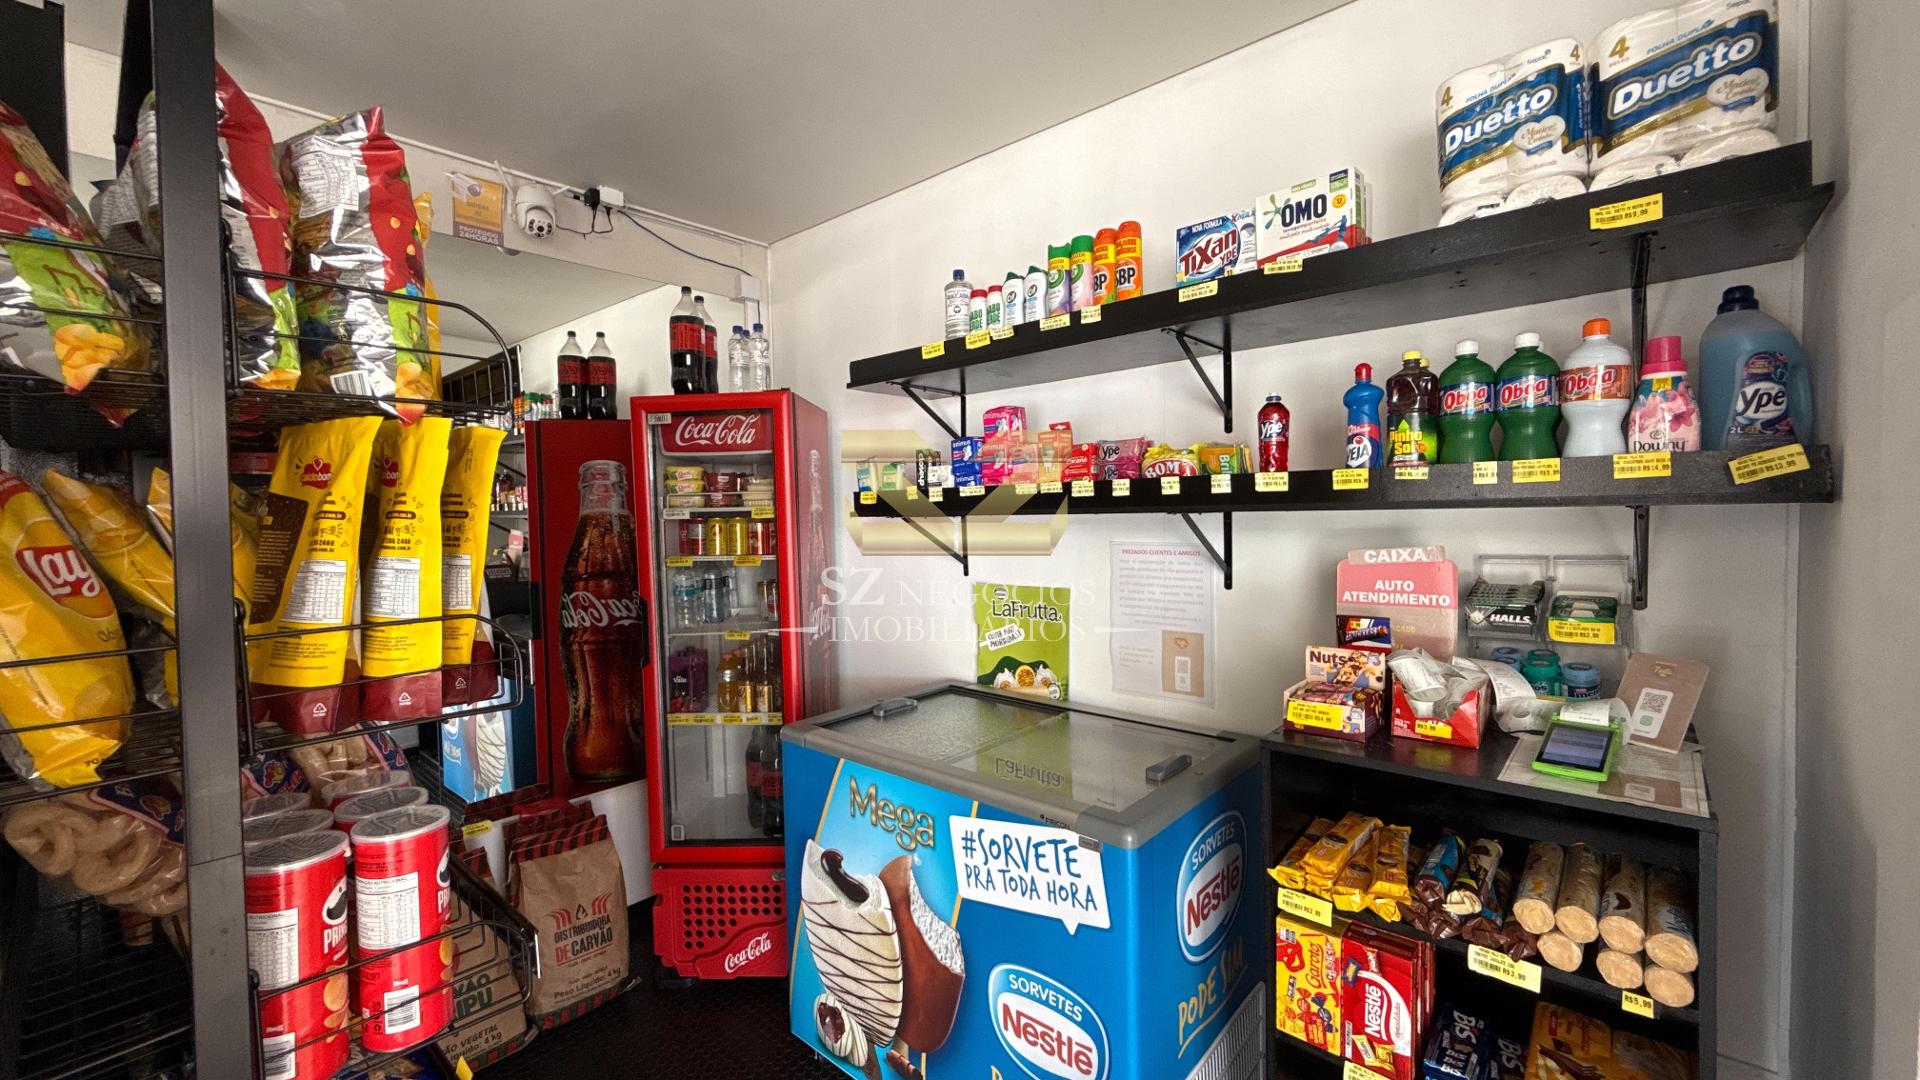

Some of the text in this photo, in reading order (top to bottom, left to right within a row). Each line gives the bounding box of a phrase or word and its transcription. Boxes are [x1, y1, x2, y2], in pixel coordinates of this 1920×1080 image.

[1571, 44, 1581, 61] 4
[1608, 35, 1630, 58] 4
[1613, 38, 1755, 115] Duetto
[1440, 86, 1453, 107] 4
[1445, 88, 1552, 159] Duetto
[1281, 193, 1327, 228] OMO
[675, 414, 761, 446] Coca-Cola
[1390, 431, 1424, 443] Pinho
[1395, 441, 1415, 455] Sol
[1145, 461, 1180, 479] BOM
[1364, 547, 1427, 563] CAIXA
[1343, 590, 1451, 606] ATENDIMENTO
[1375, 580, 1415, 592] AUTO
[1490, 614, 1531, 624] HALLS
[850, 775, 936, 852] Mega
[961, 828, 1081, 879] #SORVETE
[1191, 820, 1235, 871] SORVETES
[964, 863, 1098, 912] PRA TODA HORA
[554, 914, 612, 944] DISTRIBUIDORA
[555, 926, 613, 963] DE CARVÃO
[724, 932, 773, 974] Coca-Cola
[554, 986, 573, 999] Peso
[1008, 973, 1083, 1023] SORVETES
[1178, 965, 1217, 1046] PODE
[1624, 994, 1652, 1009] R$5,99
[461, 1024, 498, 1048] VEGETAL
